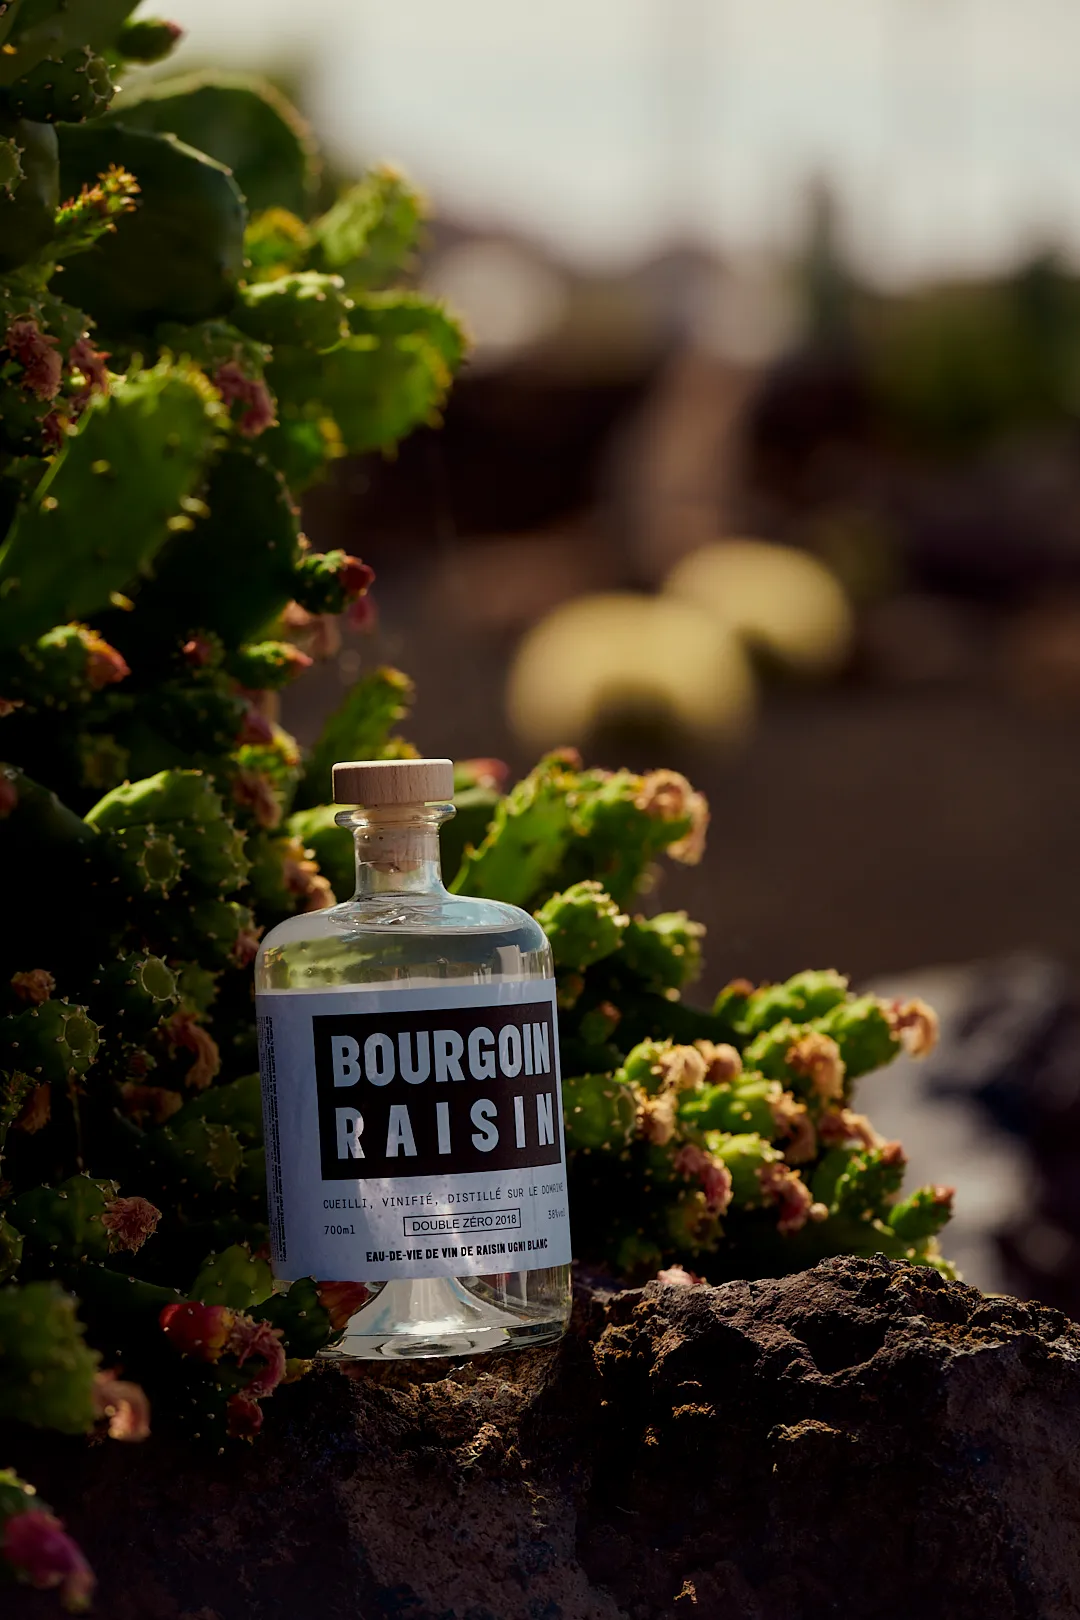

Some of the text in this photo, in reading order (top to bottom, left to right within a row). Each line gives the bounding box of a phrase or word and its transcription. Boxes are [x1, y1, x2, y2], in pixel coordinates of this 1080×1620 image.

[331, 1022, 550, 1087] BOURGOIN
[335, 1093, 555, 1159] RAISIN
[323, 1182, 564, 1209] CUEILLI, VINIFIÉ, DISTILLÉ SUR LE DOMAINE
[324, 1225, 356, 1235] 700ml
[412, 1214, 517, 1232] DOUBLE ZÉRO 2018
[365, 1238, 548, 1262] EAU-DE-VIE DE VIN DE RAISIN UGNI BLANC
